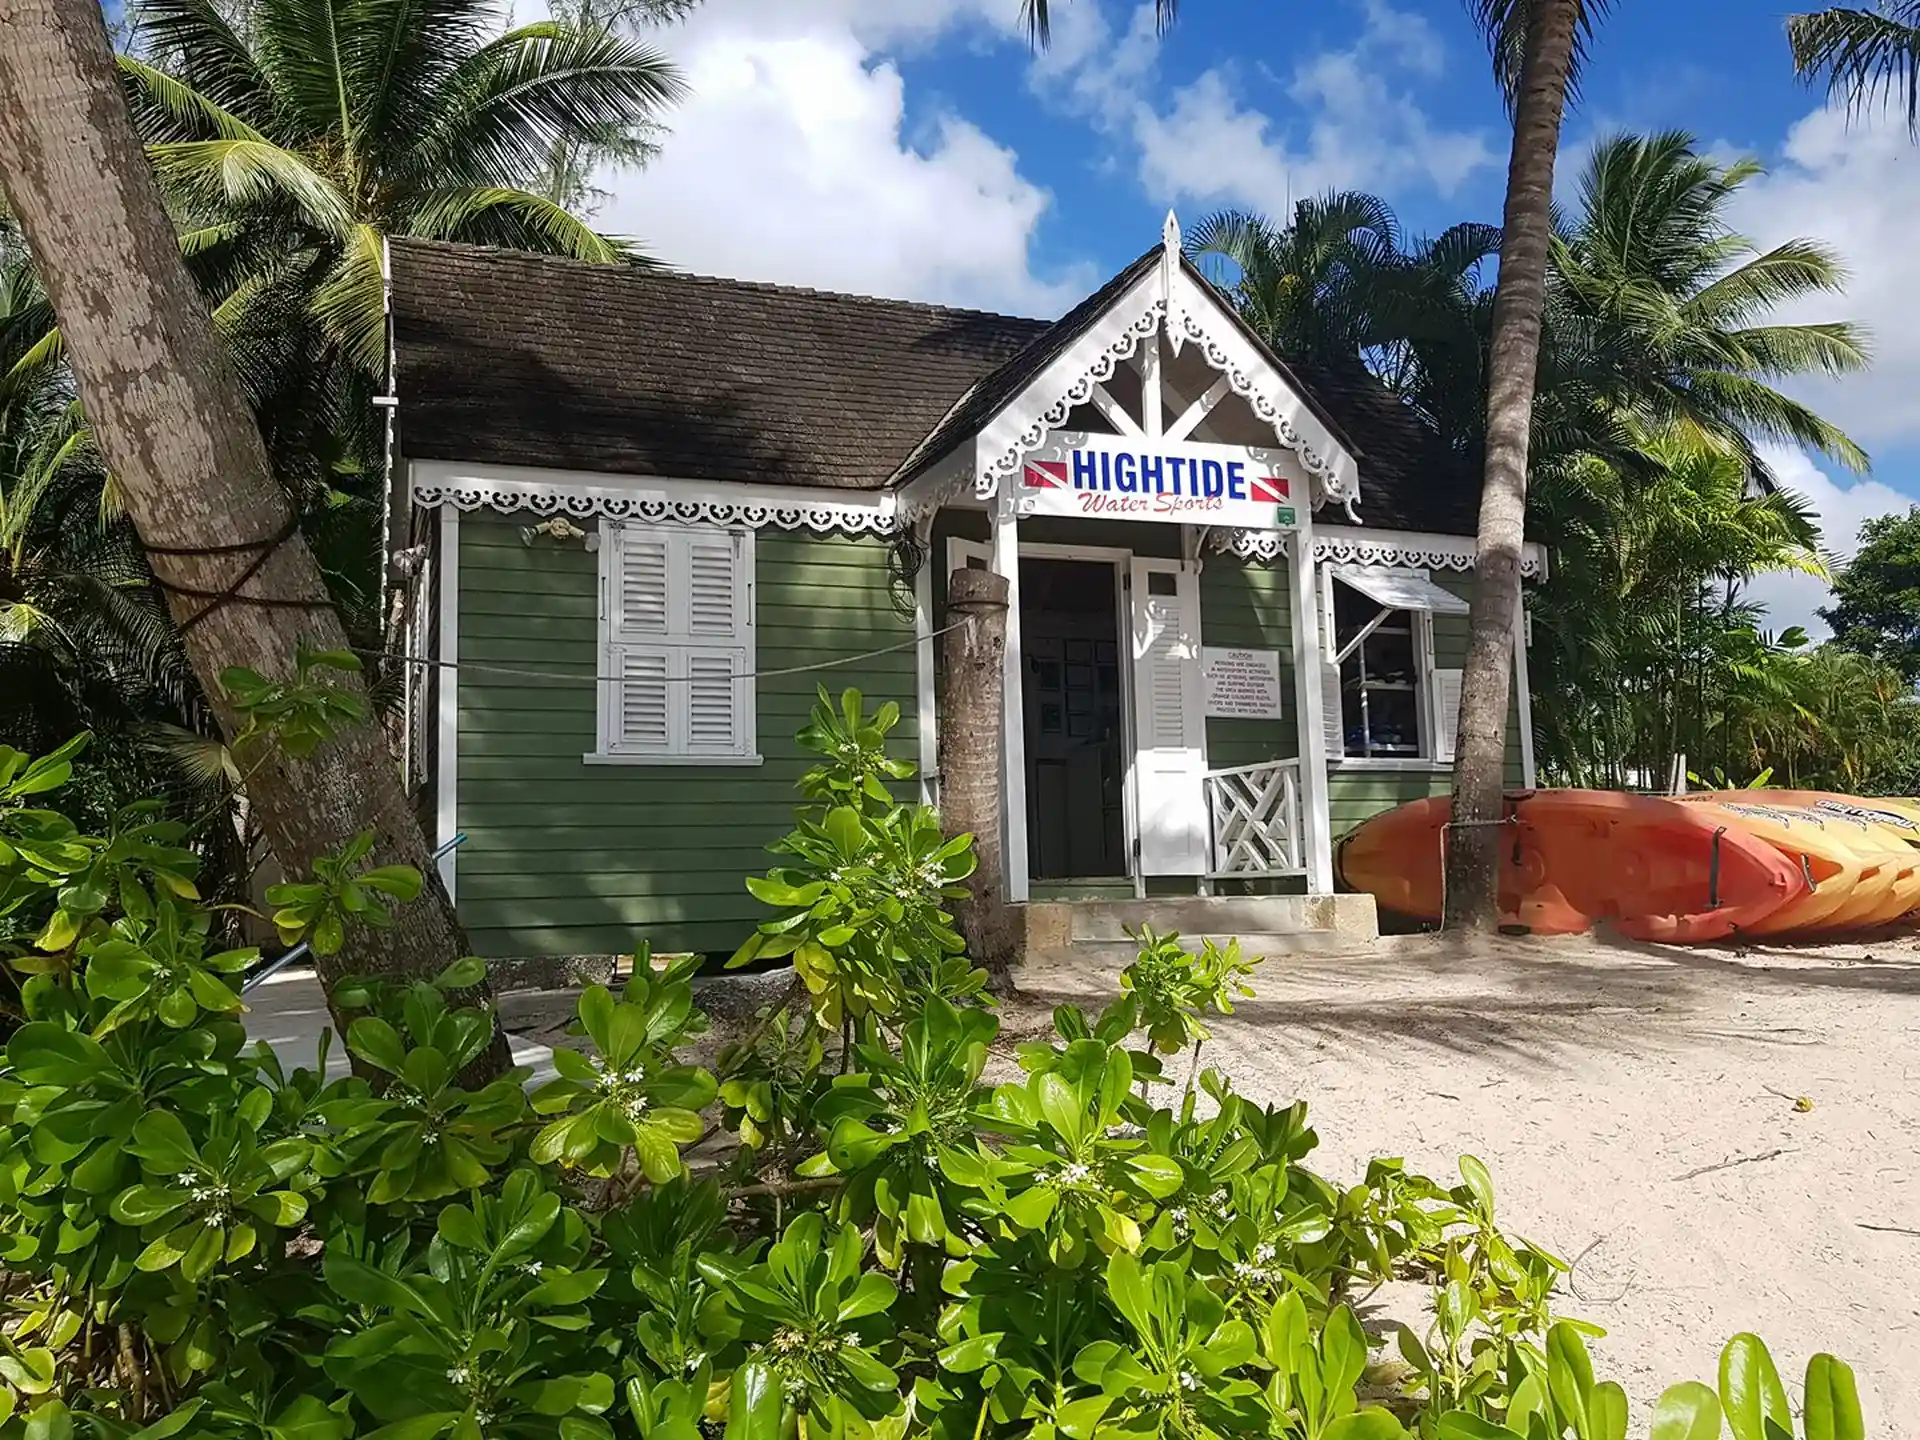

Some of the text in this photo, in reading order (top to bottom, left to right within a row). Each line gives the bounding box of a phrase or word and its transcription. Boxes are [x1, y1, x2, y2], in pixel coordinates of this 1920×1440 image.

[1072, 449, 1247, 501] HIGHTIDE
[1077, 491, 1224, 515] Water Sports
